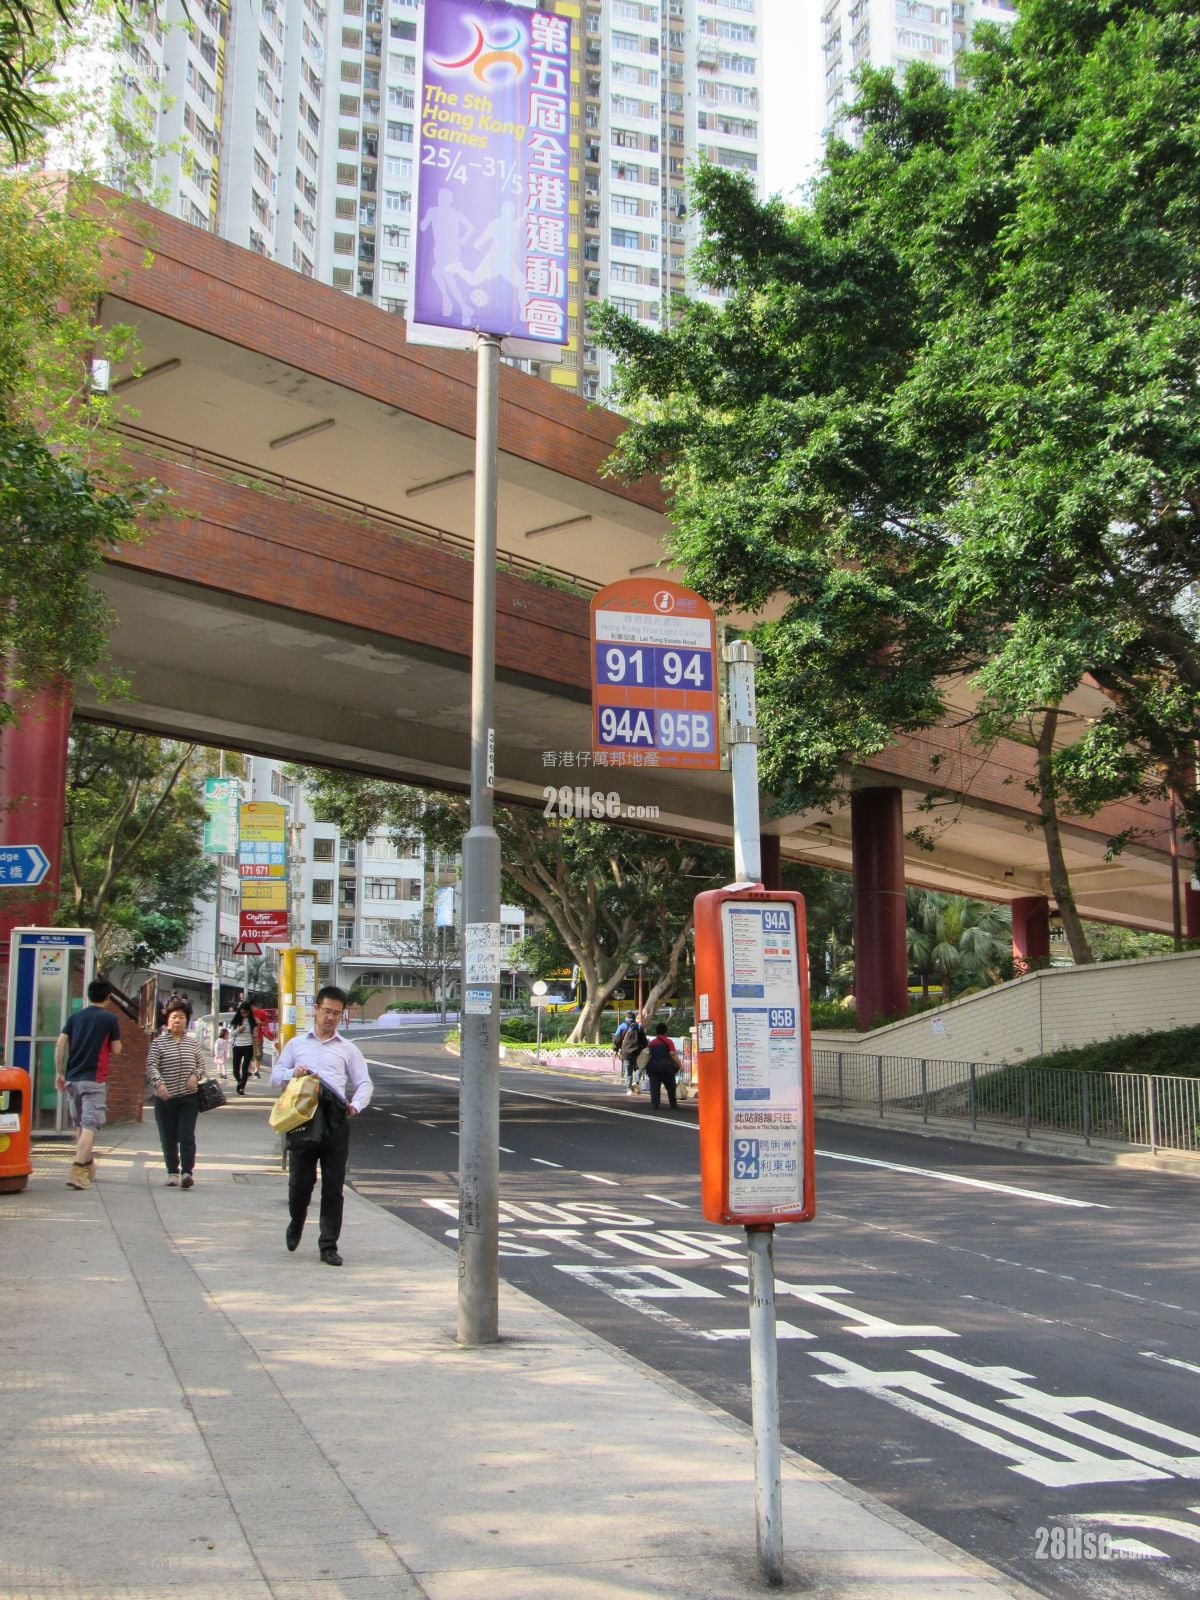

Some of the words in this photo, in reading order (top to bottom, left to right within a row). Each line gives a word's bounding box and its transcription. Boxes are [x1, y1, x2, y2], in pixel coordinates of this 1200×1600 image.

[424, 84, 458, 106] The
[462, 92, 493, 113] 5th
[422, 102, 474, 131] Hong
[478, 114, 526, 140] Kong
[422, 121, 488, 149] Games
[524, 12, 568, 342] 第五屆全港運動會
[606, 648, 644, 683] 91
[662, 652, 704, 687] 94
[601, 708, 654, 745] 94A
[660, 712, 710, 748] 95B
[241, 865, 253, 876] 171
[241, 929, 258, 938] A10
[764, 911, 788, 929] 94A
[771, 1009, 793, 1027] 95B
[738, 1140, 756, 1158] 91
[736, 1160, 758, 1178] 94
[445, 1228, 750, 1259] STOP
